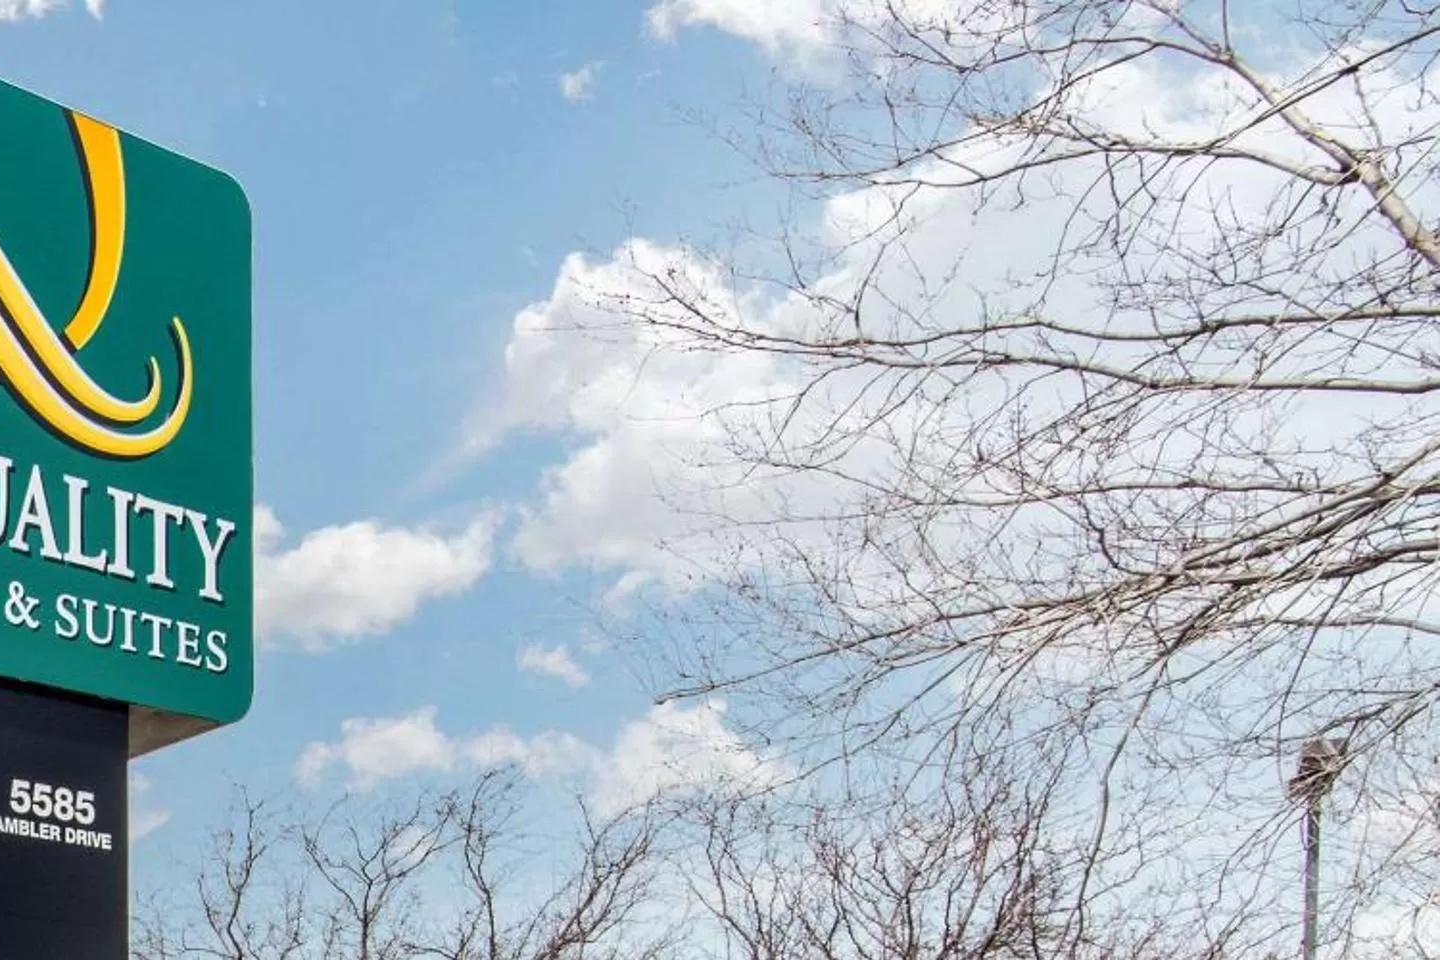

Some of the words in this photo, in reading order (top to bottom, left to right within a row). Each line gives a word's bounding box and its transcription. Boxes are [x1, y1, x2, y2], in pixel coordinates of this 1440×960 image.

[4, 580, 41, 629] &
[55, 594, 229, 673] SUITES
[9, 779, 96, 825] 5585
[64, 827, 112, 850] DRIVE
